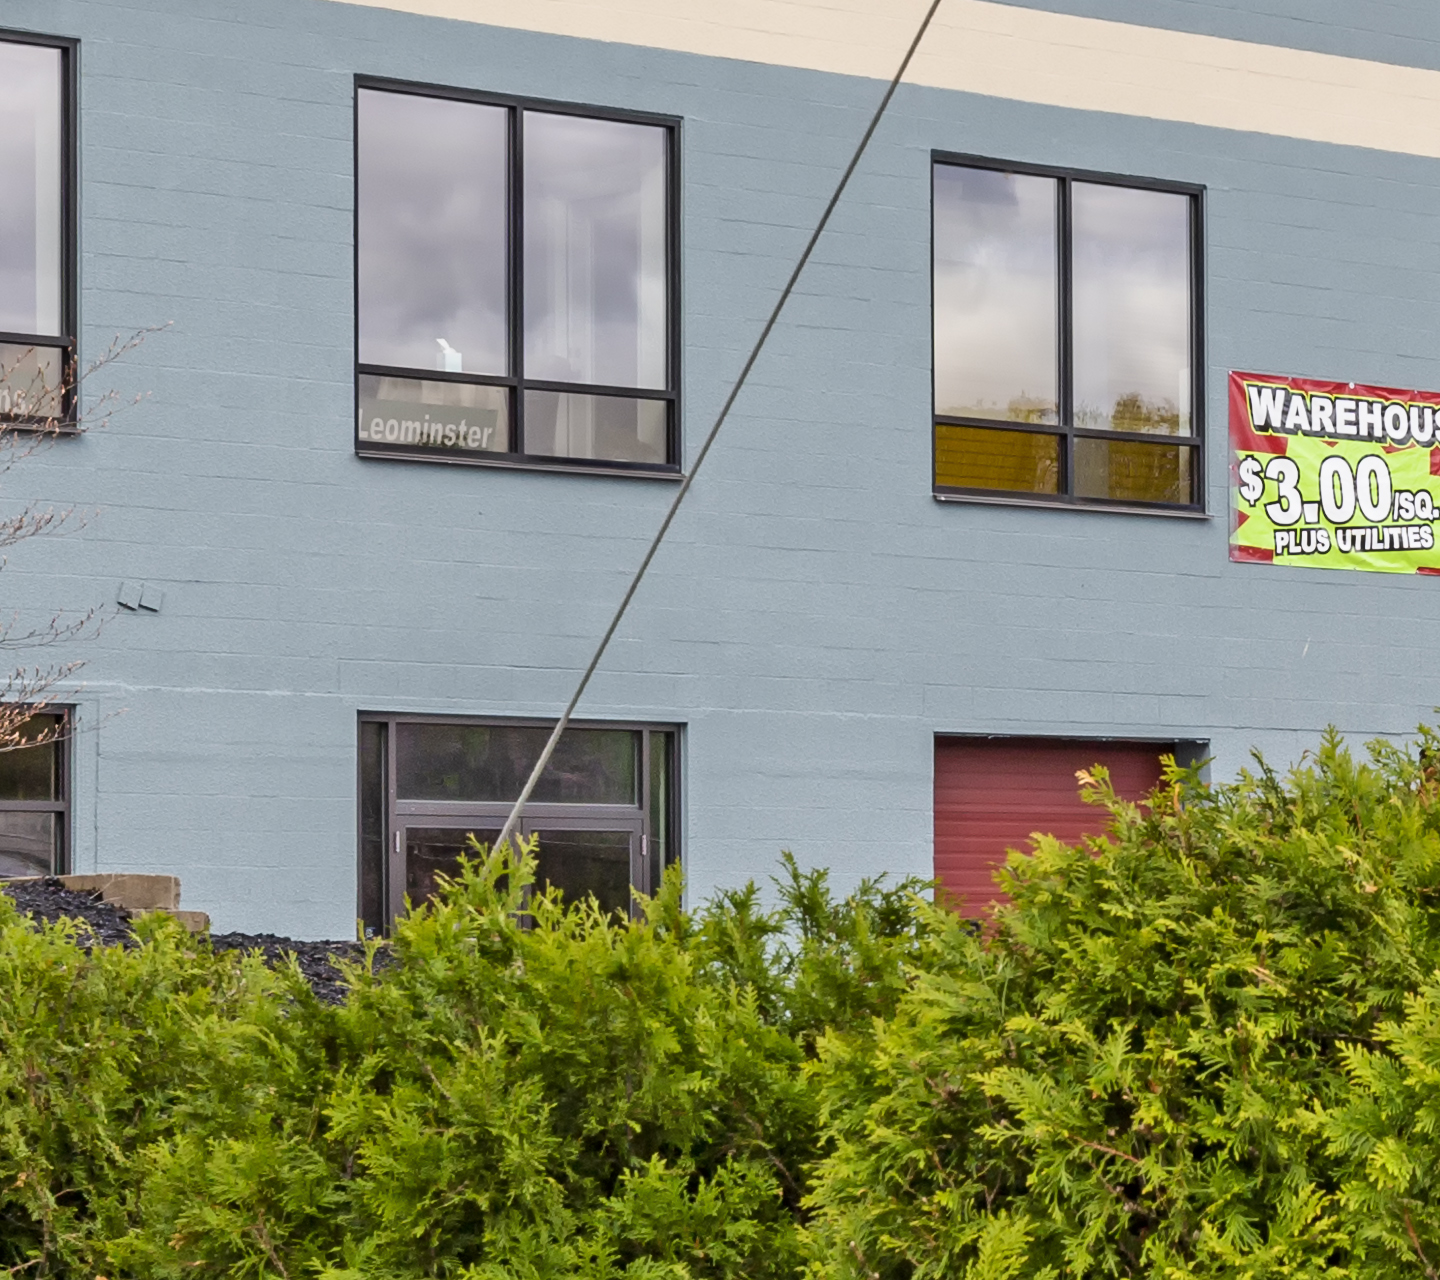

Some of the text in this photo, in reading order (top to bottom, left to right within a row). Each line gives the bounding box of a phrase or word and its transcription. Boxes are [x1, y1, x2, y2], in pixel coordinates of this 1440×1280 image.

[358, 408, 493, 449] Leominster
[1274, 523, 1435, 556] PLUS UTILITIES
